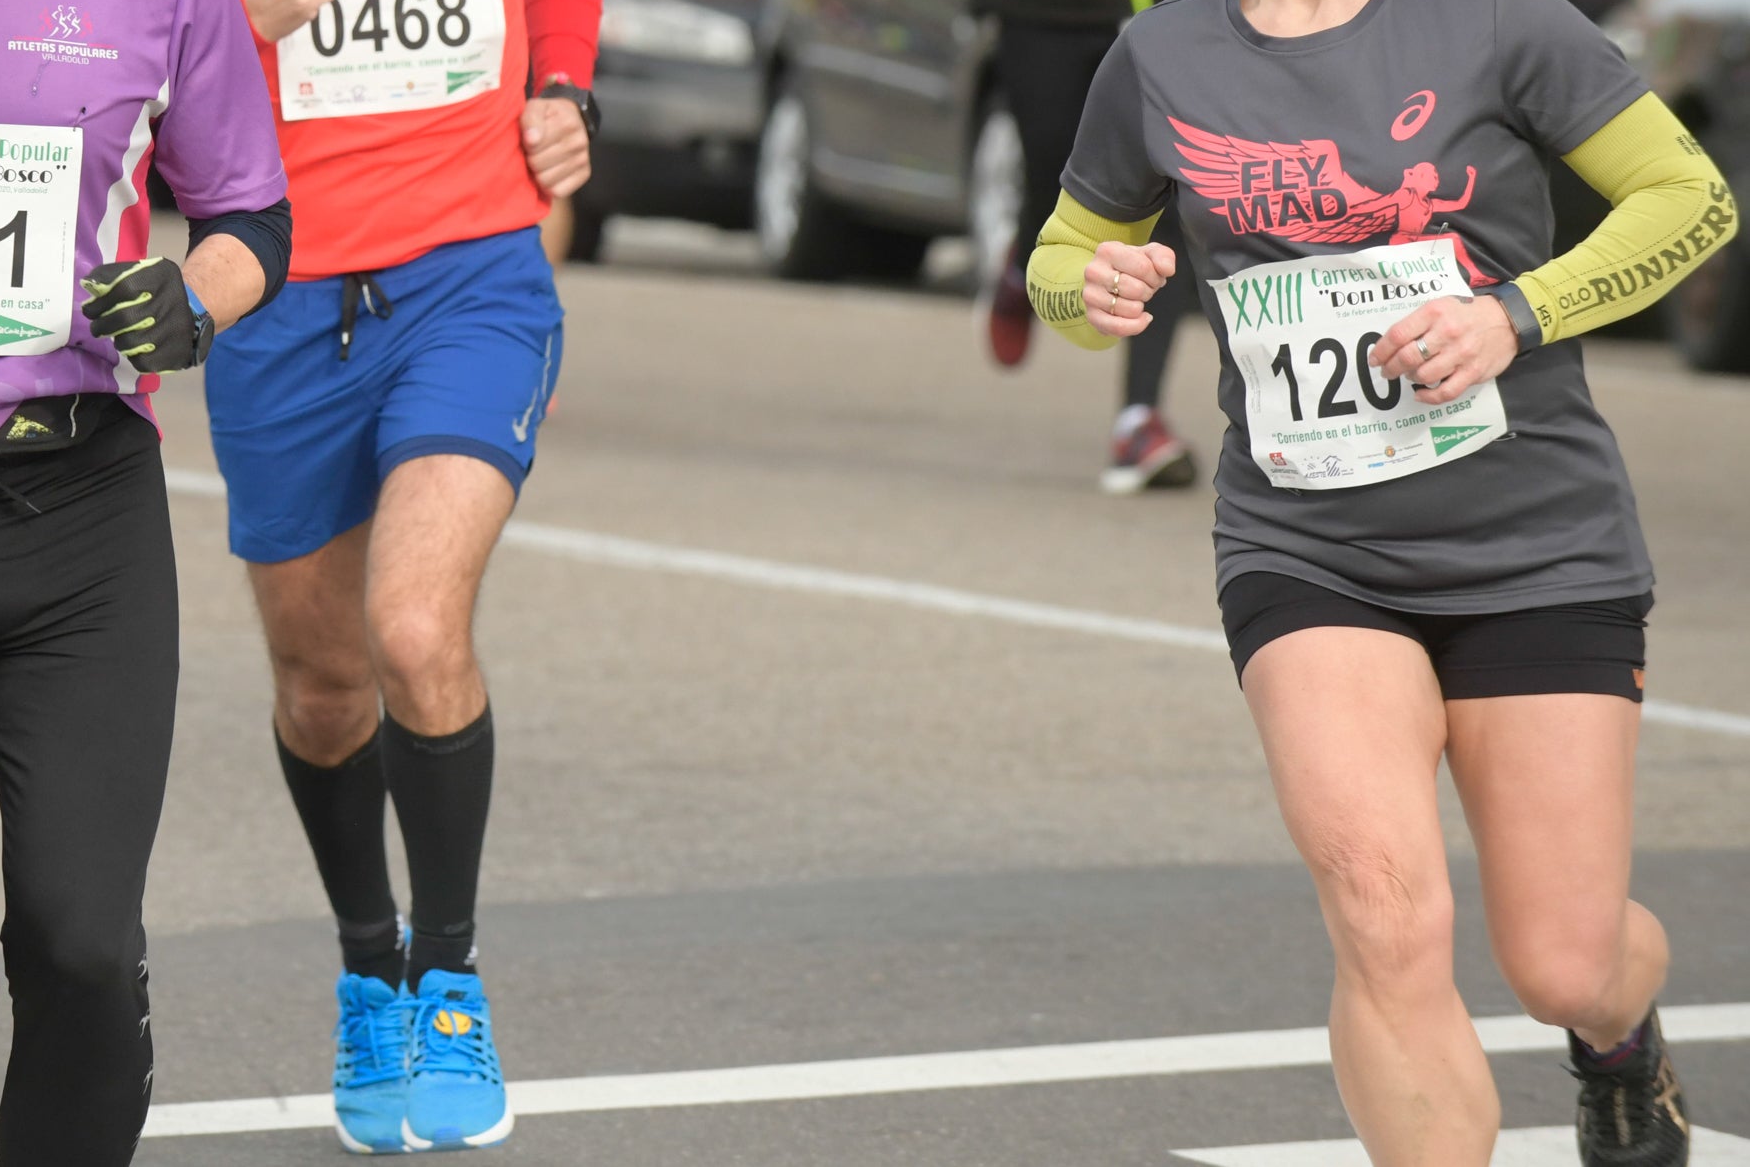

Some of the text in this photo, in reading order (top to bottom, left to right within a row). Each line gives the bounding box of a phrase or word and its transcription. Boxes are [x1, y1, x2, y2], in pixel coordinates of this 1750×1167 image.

[7, 40, 119, 60] ATLETAS POPULARES
[41, 53, 90, 65] VALLADOLID
[0, 139, 73, 163] Popular
[1241, 154, 1329, 195] FLY
[1227, 188, 1348, 233] MAD
[1588, 181, 1734, 306] RUNNERS
[1311, 256, 1447, 288] Carrera Popular
[1, 299, 14, 309] en
[1228, 272, 1303, 334] XXIII
[1271, 331, 1450, 422] 120
[1325, 429, 1338, 439] en
[1341, 426, 1351, 438] el
[1354, 421, 1393, 436] barrio,
[1396, 415, 1426, 429] como
[1429, 409, 1443, 420] en
